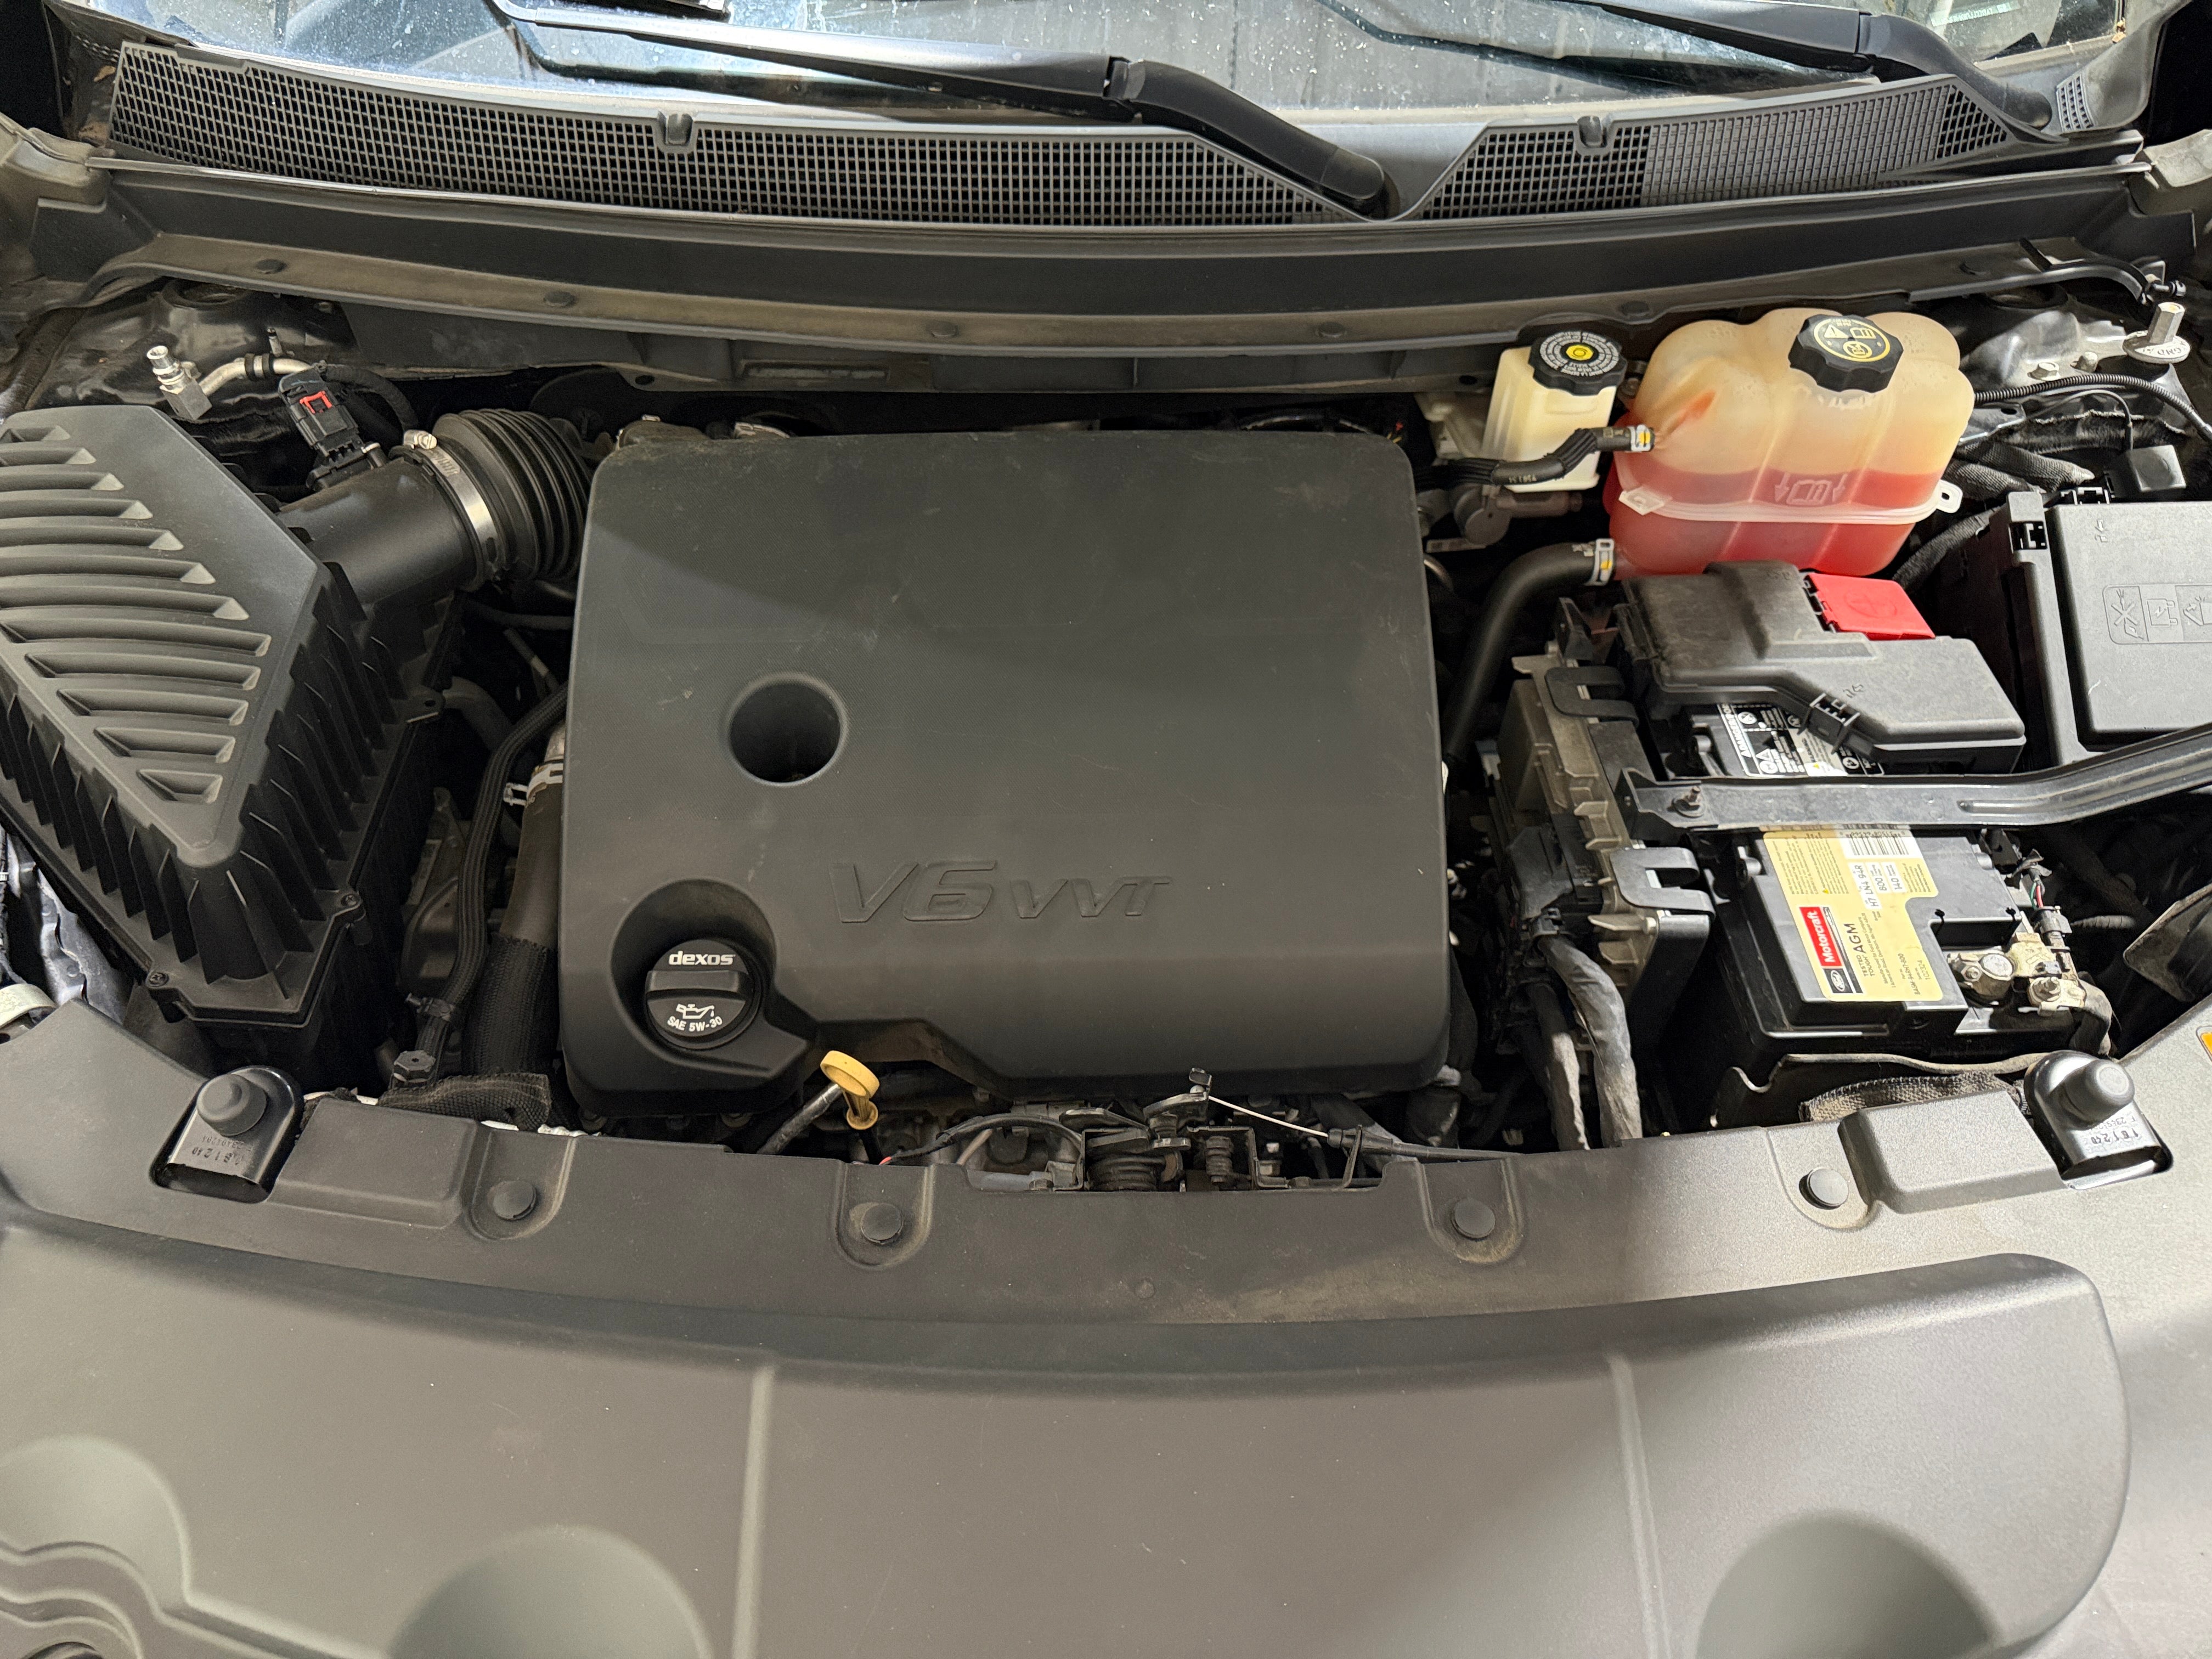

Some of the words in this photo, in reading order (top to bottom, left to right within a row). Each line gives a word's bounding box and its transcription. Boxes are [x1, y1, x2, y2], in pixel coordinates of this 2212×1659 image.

[1875, 877, 1887, 890] 800
[1891, 877, 1903, 889] 140
[1009, 876, 1171, 918] VVT
[1867, 898, 1878, 906] H7
[1805, 911, 1835, 962] Motorcraft
[1843, 923, 1866, 953] AGM
[669, 951, 735, 966] dexos
[1856, 955, 1869, 976] TESTED
[667, 1016, 686, 1030] SAE
[689, 1016, 723, 1032] 5W-30
